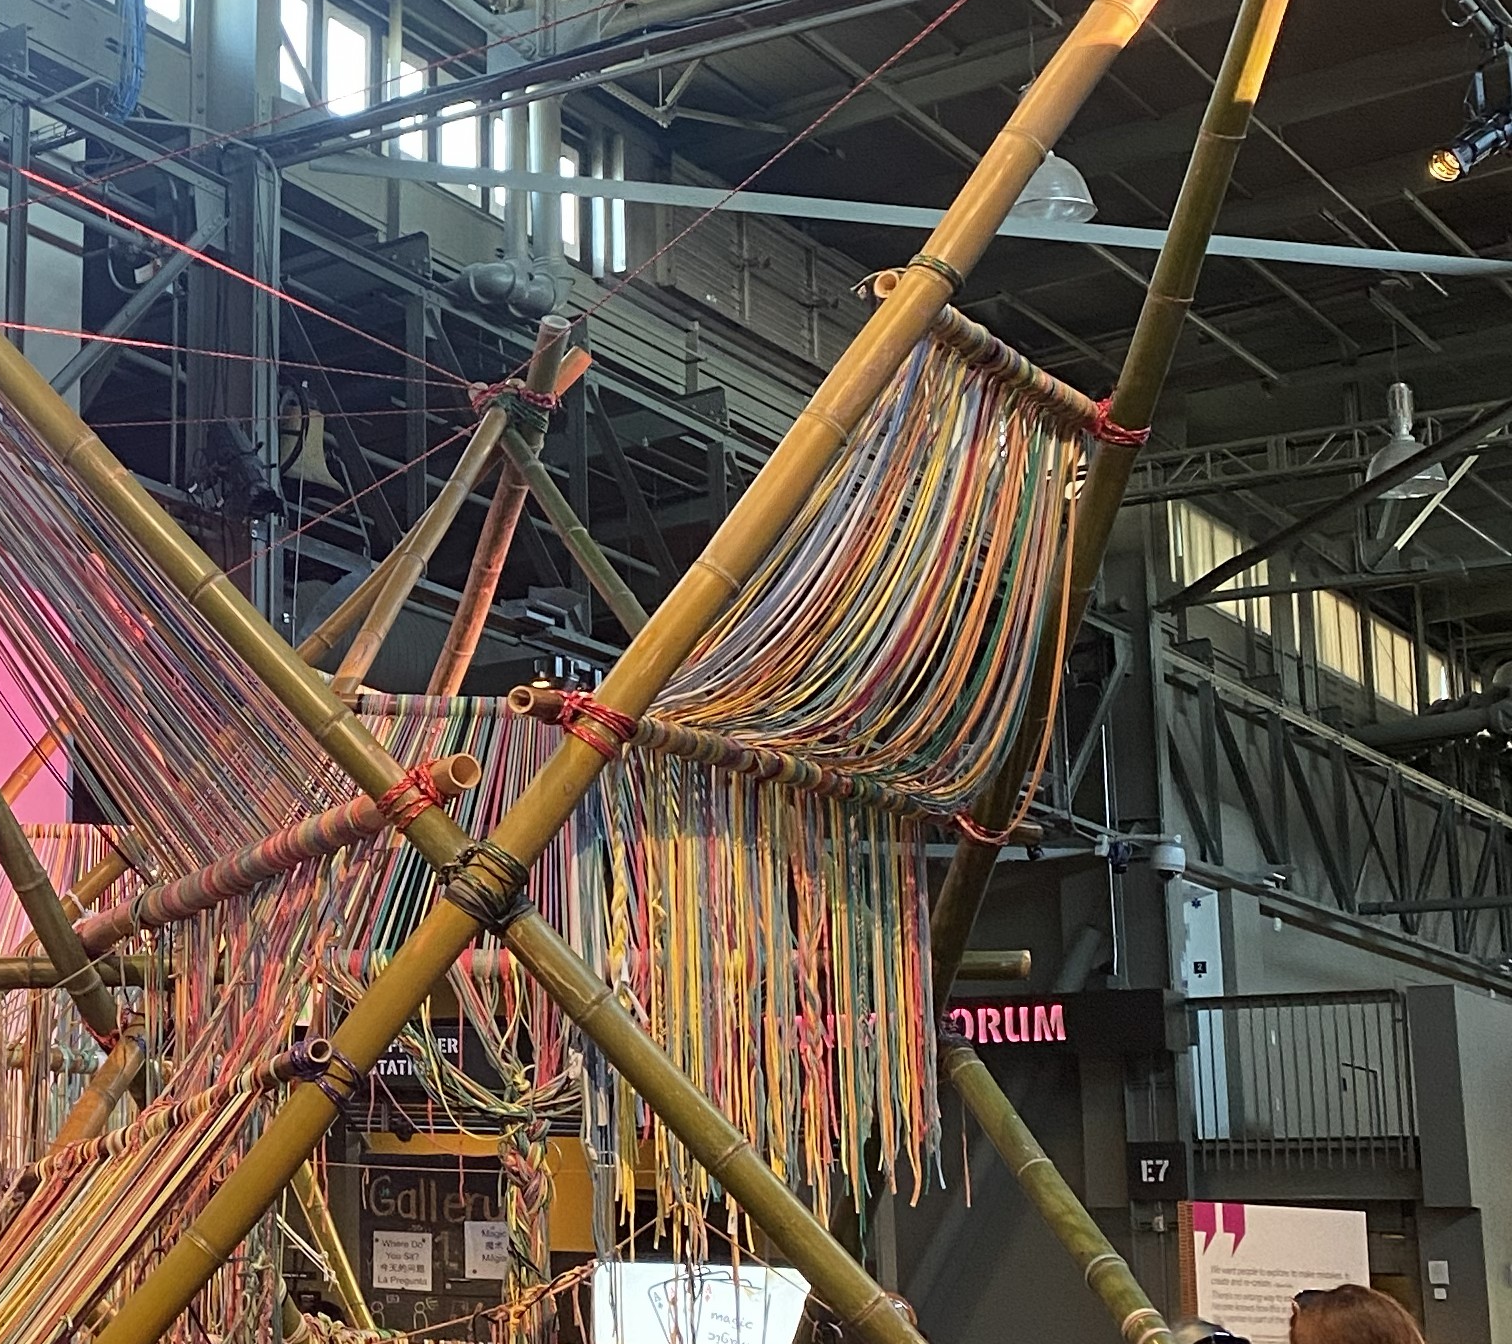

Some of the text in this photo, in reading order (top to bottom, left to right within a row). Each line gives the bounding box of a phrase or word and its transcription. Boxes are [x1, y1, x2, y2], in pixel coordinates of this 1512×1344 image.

[948, 1004, 1067, 1044] ORUM
[1140, 1159, 1170, 1182] E7
[381, 1239, 424, 1249] Where Do
[386, 1252, 402, 1260] You
[377, 1275, 428, 1286] La Pregunta
